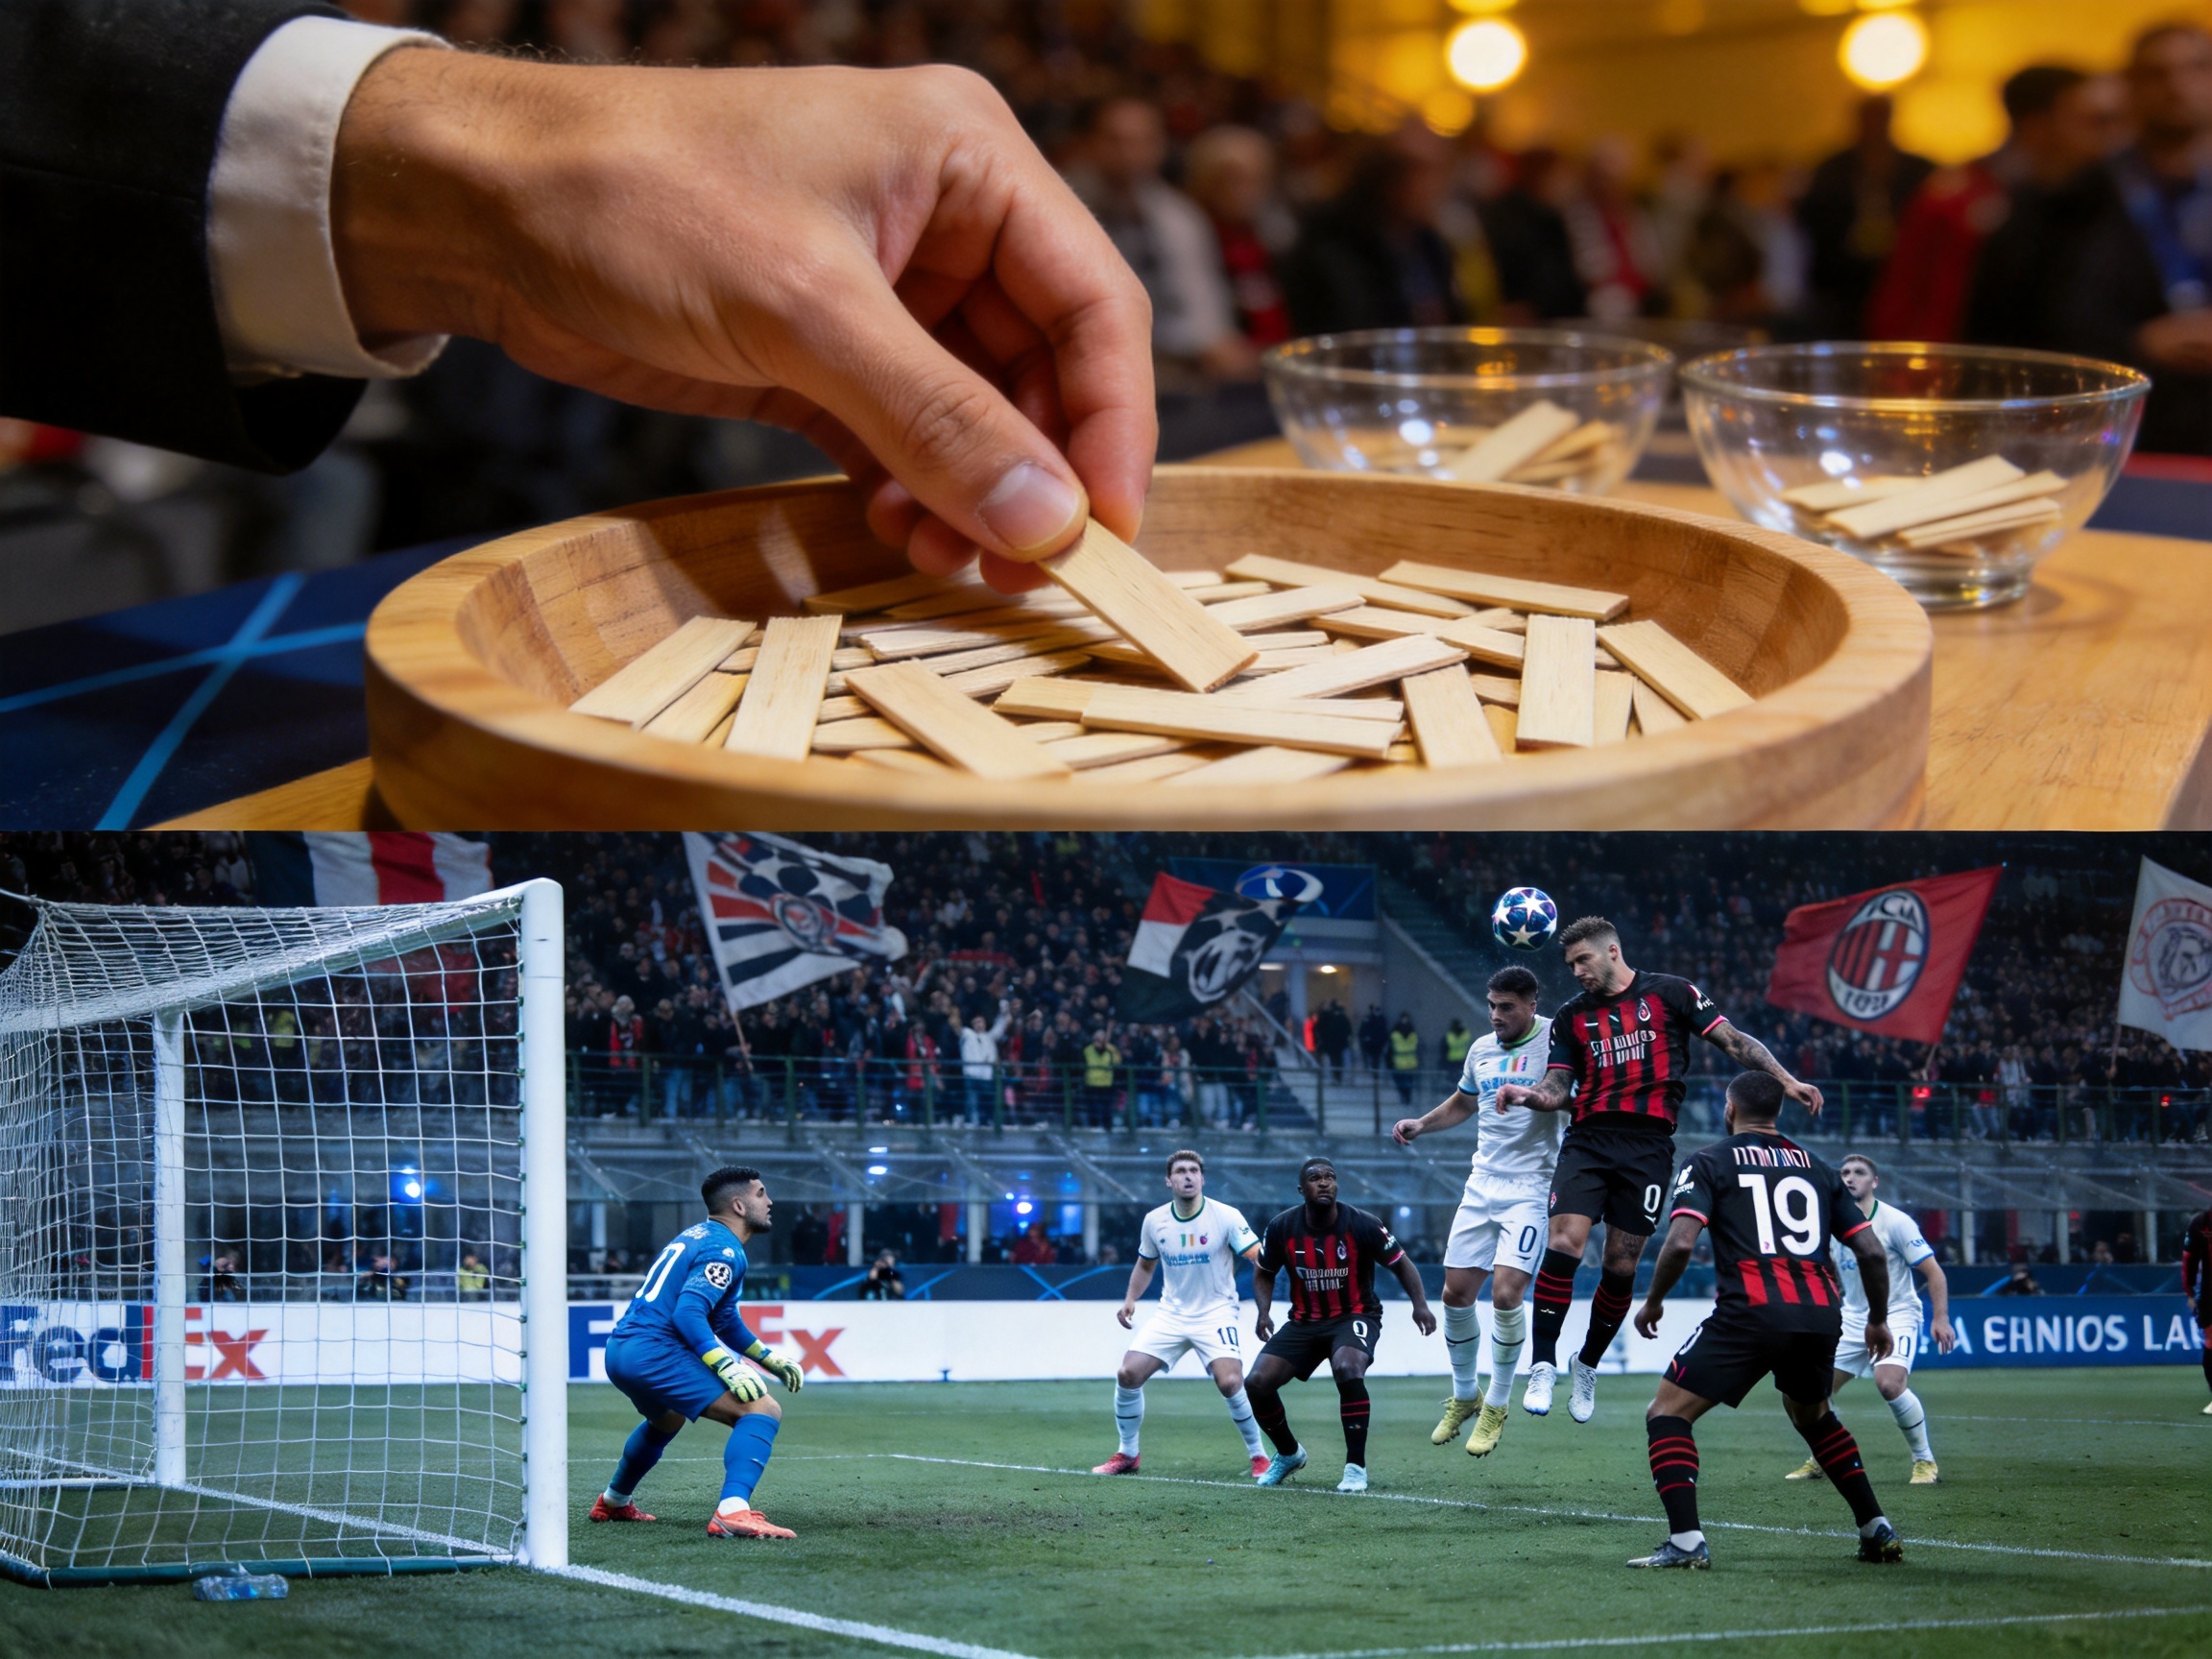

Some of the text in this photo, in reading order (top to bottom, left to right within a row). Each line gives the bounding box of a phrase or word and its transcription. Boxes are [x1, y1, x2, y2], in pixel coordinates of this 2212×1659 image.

[1643, 1184, 1662, 1214] 0
[1738, 1173, 1821, 1256] 19
[1518, 1225, 1536, 1253] 0
